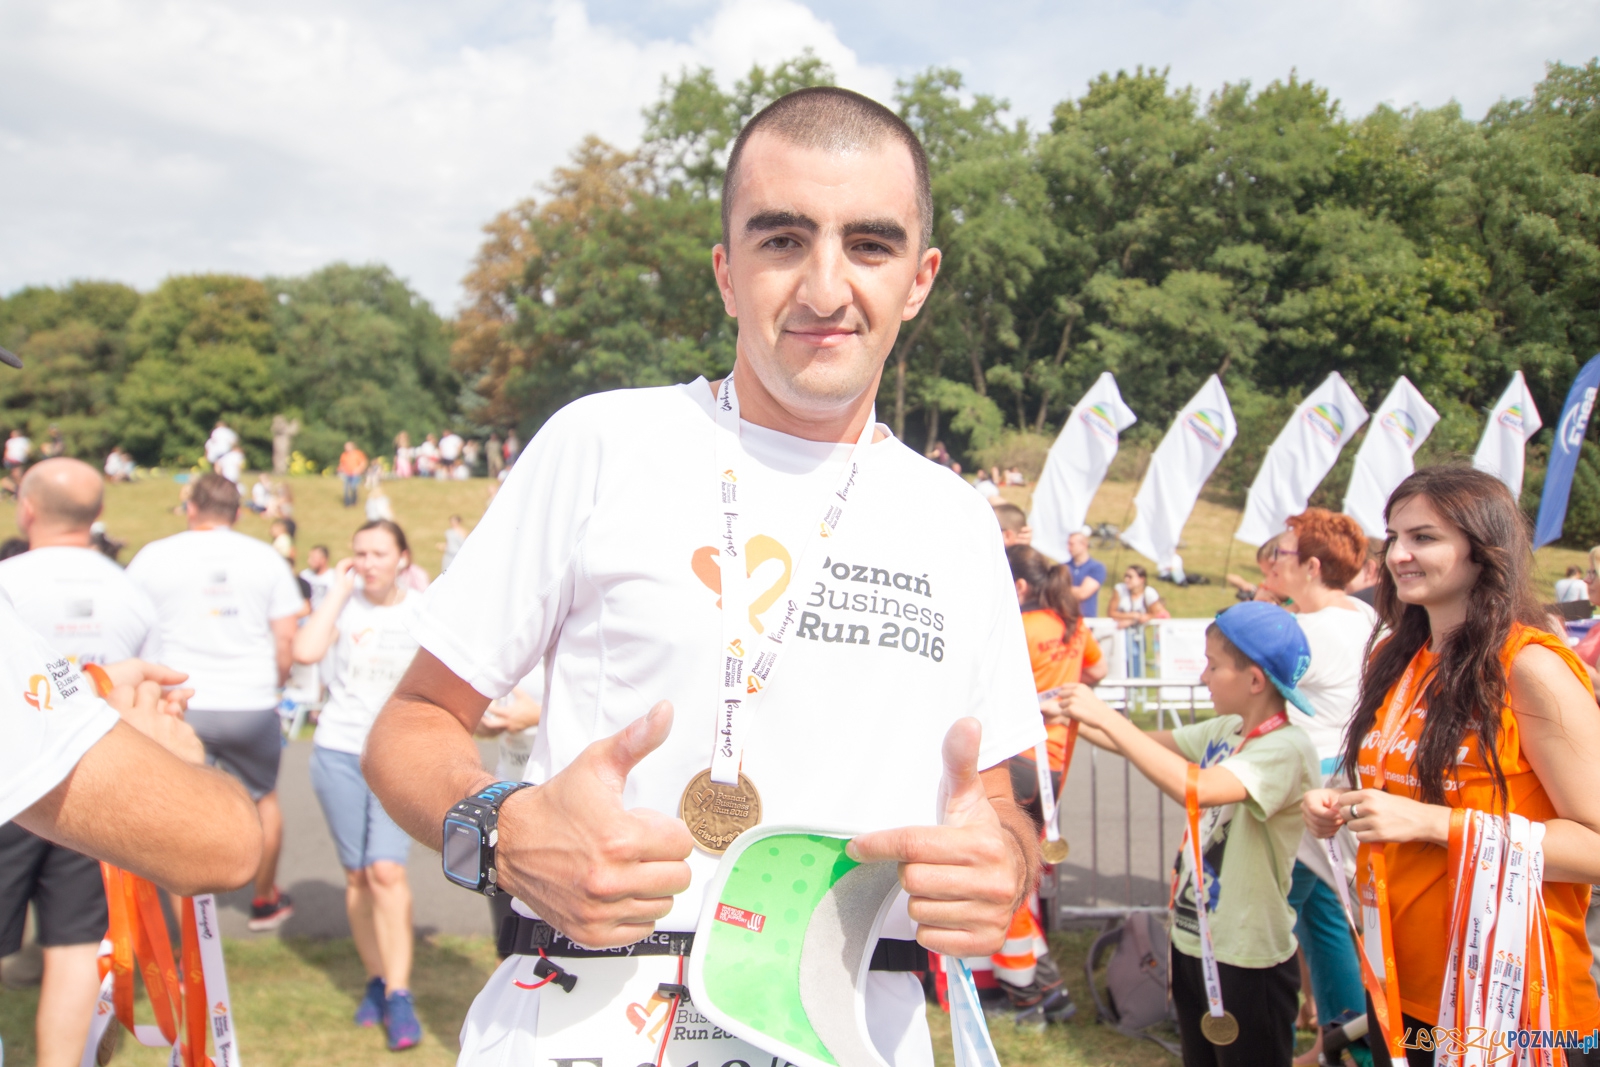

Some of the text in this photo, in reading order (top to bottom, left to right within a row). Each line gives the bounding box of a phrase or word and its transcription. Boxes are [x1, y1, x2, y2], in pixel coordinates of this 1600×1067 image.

[1568, 386, 1598, 447] Enea
[822, 556, 932, 598] oznań
[806, 581, 945, 631] Business
[796, 611, 945, 662] Run 2016
[60, 685, 79, 700] Run
[673, 1027, 708, 1040] Run
